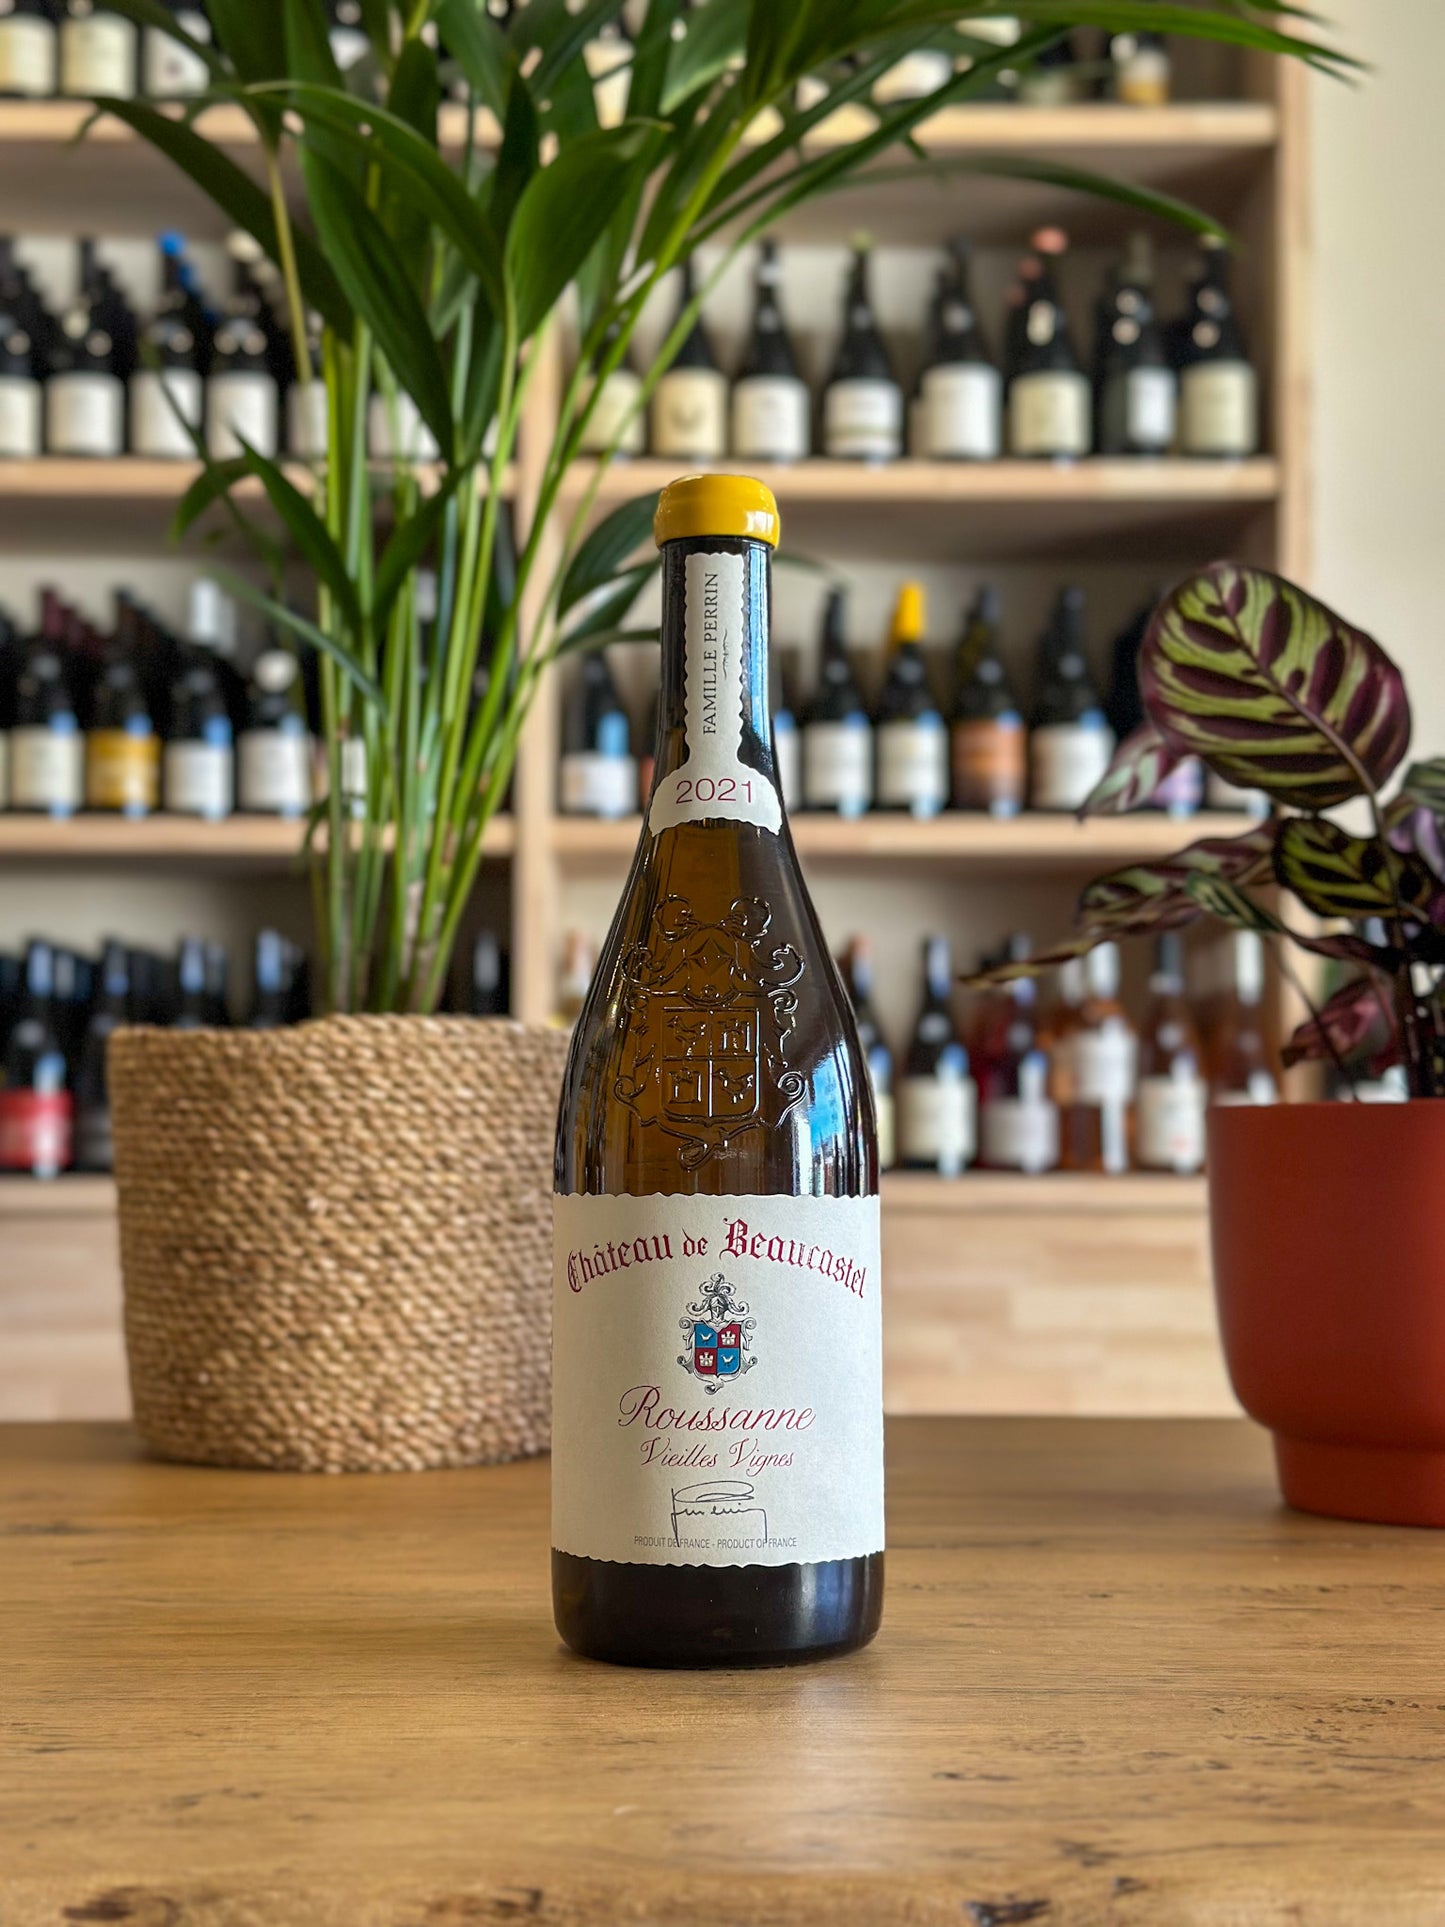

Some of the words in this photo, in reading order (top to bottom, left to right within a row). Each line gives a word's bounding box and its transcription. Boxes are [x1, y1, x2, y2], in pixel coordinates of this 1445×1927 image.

[704, 573, 718, 643] PERRIN
[703, 649, 717, 735] FAMILLE
[676, 778, 752, 804] 2021
[682, 1228, 709, 1257] de
[719, 1217, 868, 1299] Beaucastel
[618, 1385, 817, 1431] Roussanne
[640, 1437, 718, 1469] Vieilles
[729, 1437, 795, 1477] Vignes
[634, 1535, 666, 1548] PRODUIT
[680, 1537, 710, 1549] FRANCE
[717, 1538, 753, 1549] PRODUCT
[768, 1536, 797, 1547] FRANCE
